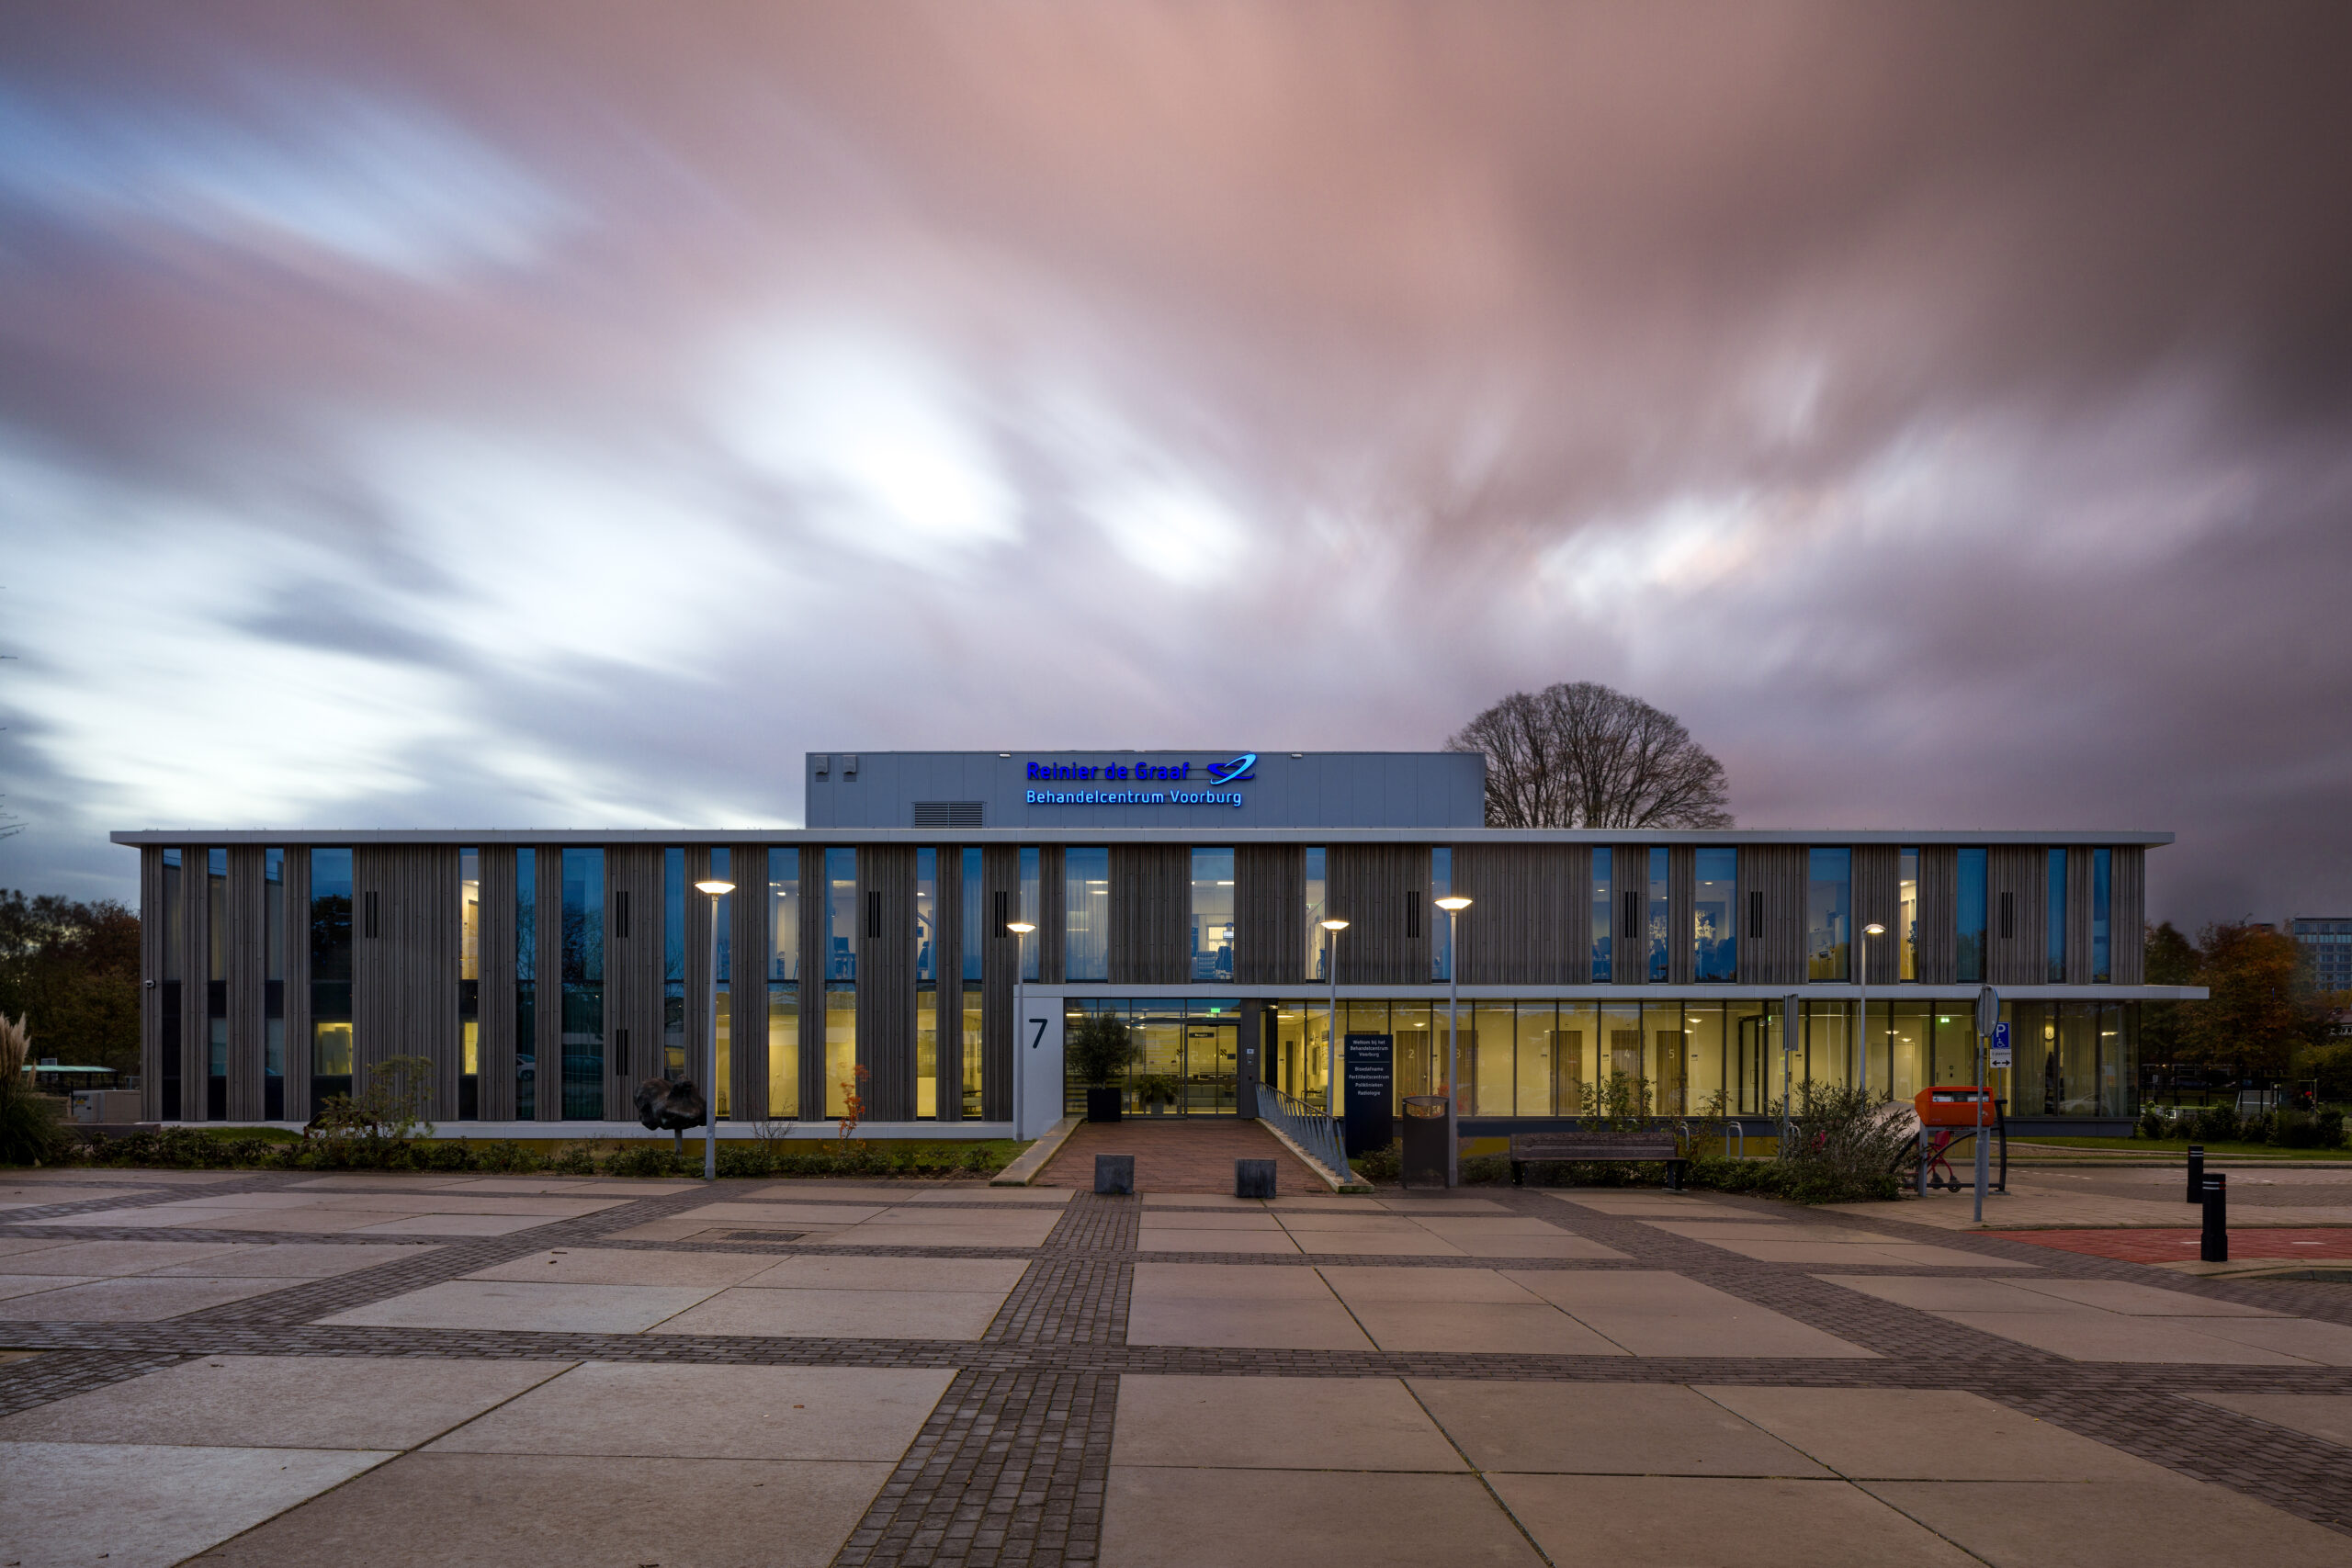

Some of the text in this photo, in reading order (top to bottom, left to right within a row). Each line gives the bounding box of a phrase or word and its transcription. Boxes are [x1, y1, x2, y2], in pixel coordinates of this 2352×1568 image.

[1027, 761, 1190, 780] Reinier de Graaf
[1026, 790, 1242, 807] Behandelcentrum Voorburg
[1028, 1018, 1048, 1049] 7
[1996, 1023, 2007, 1038] P
